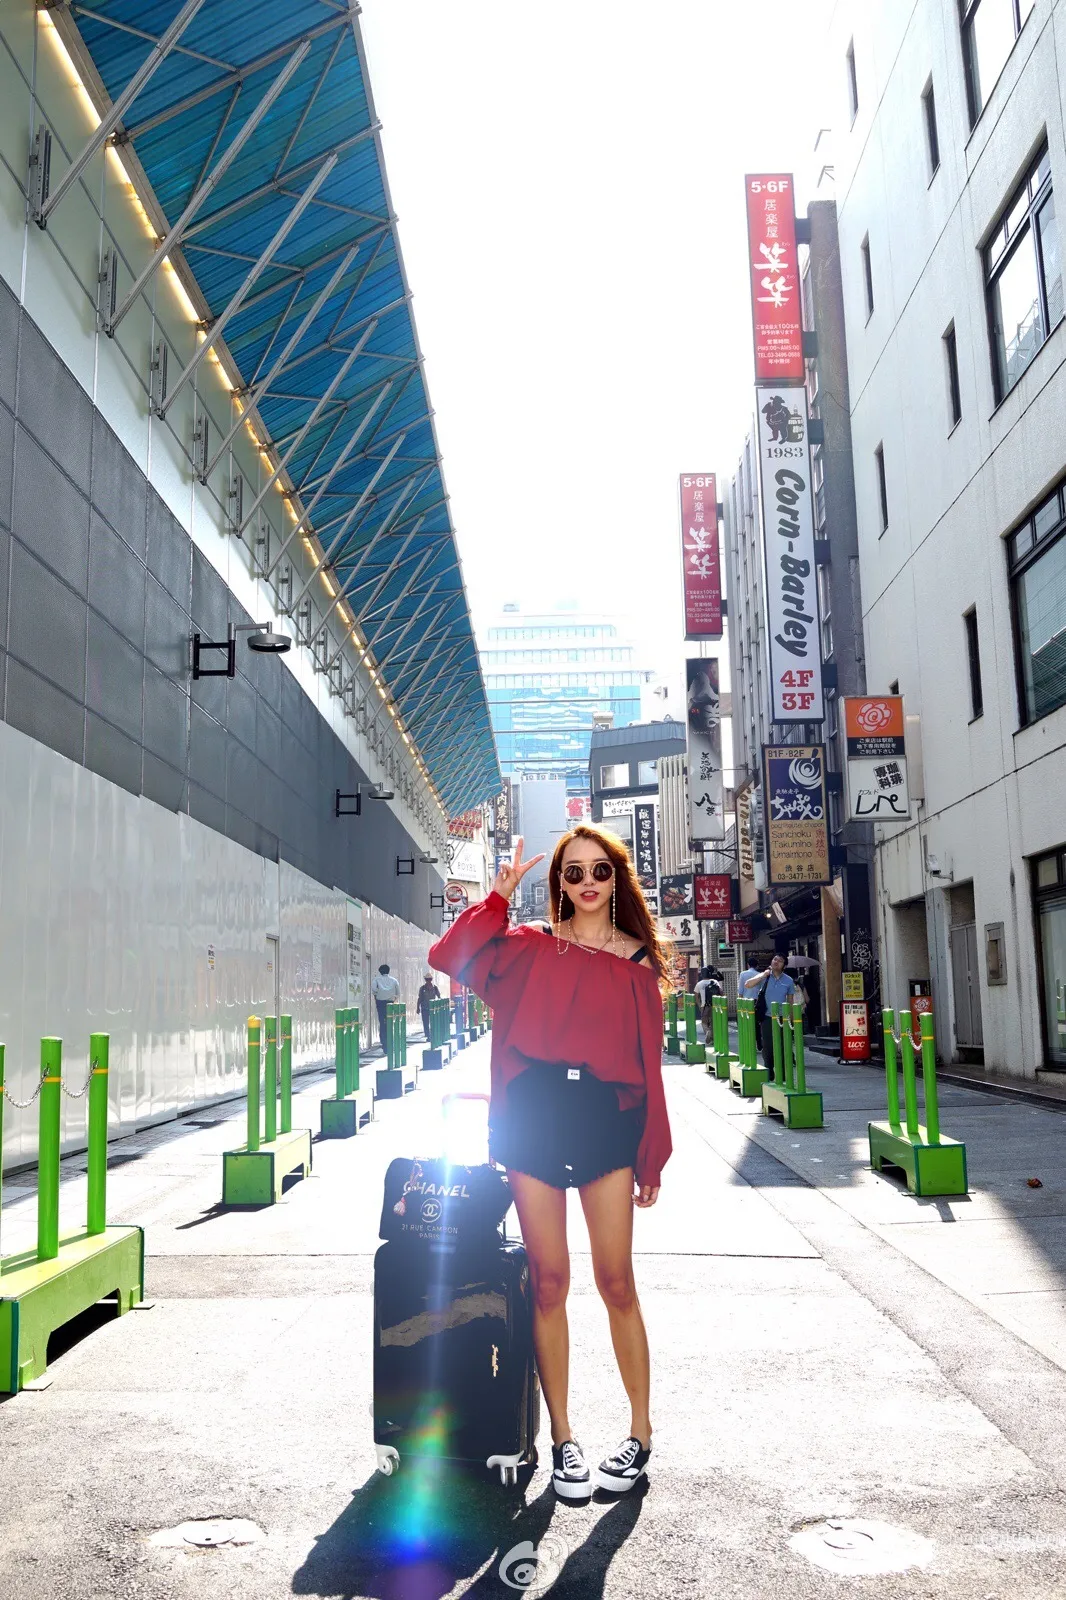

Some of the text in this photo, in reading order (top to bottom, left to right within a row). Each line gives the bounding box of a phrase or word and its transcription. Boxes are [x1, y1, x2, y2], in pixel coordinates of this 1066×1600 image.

[764, 198, 778, 238] 居楽屋
[766, 448, 804, 458] 1983
[693, 490, 704, 522] 居楽屋
[775, 468, 814, 658] Corn-Barley
[780, 670, 814, 688] 4F
[782, 692, 815, 711] 3F
[772, 830, 811, 838] Sanchoku
[772, 840, 812, 848] Takumino
[403, 1181, 470, 1198] CHANEL
